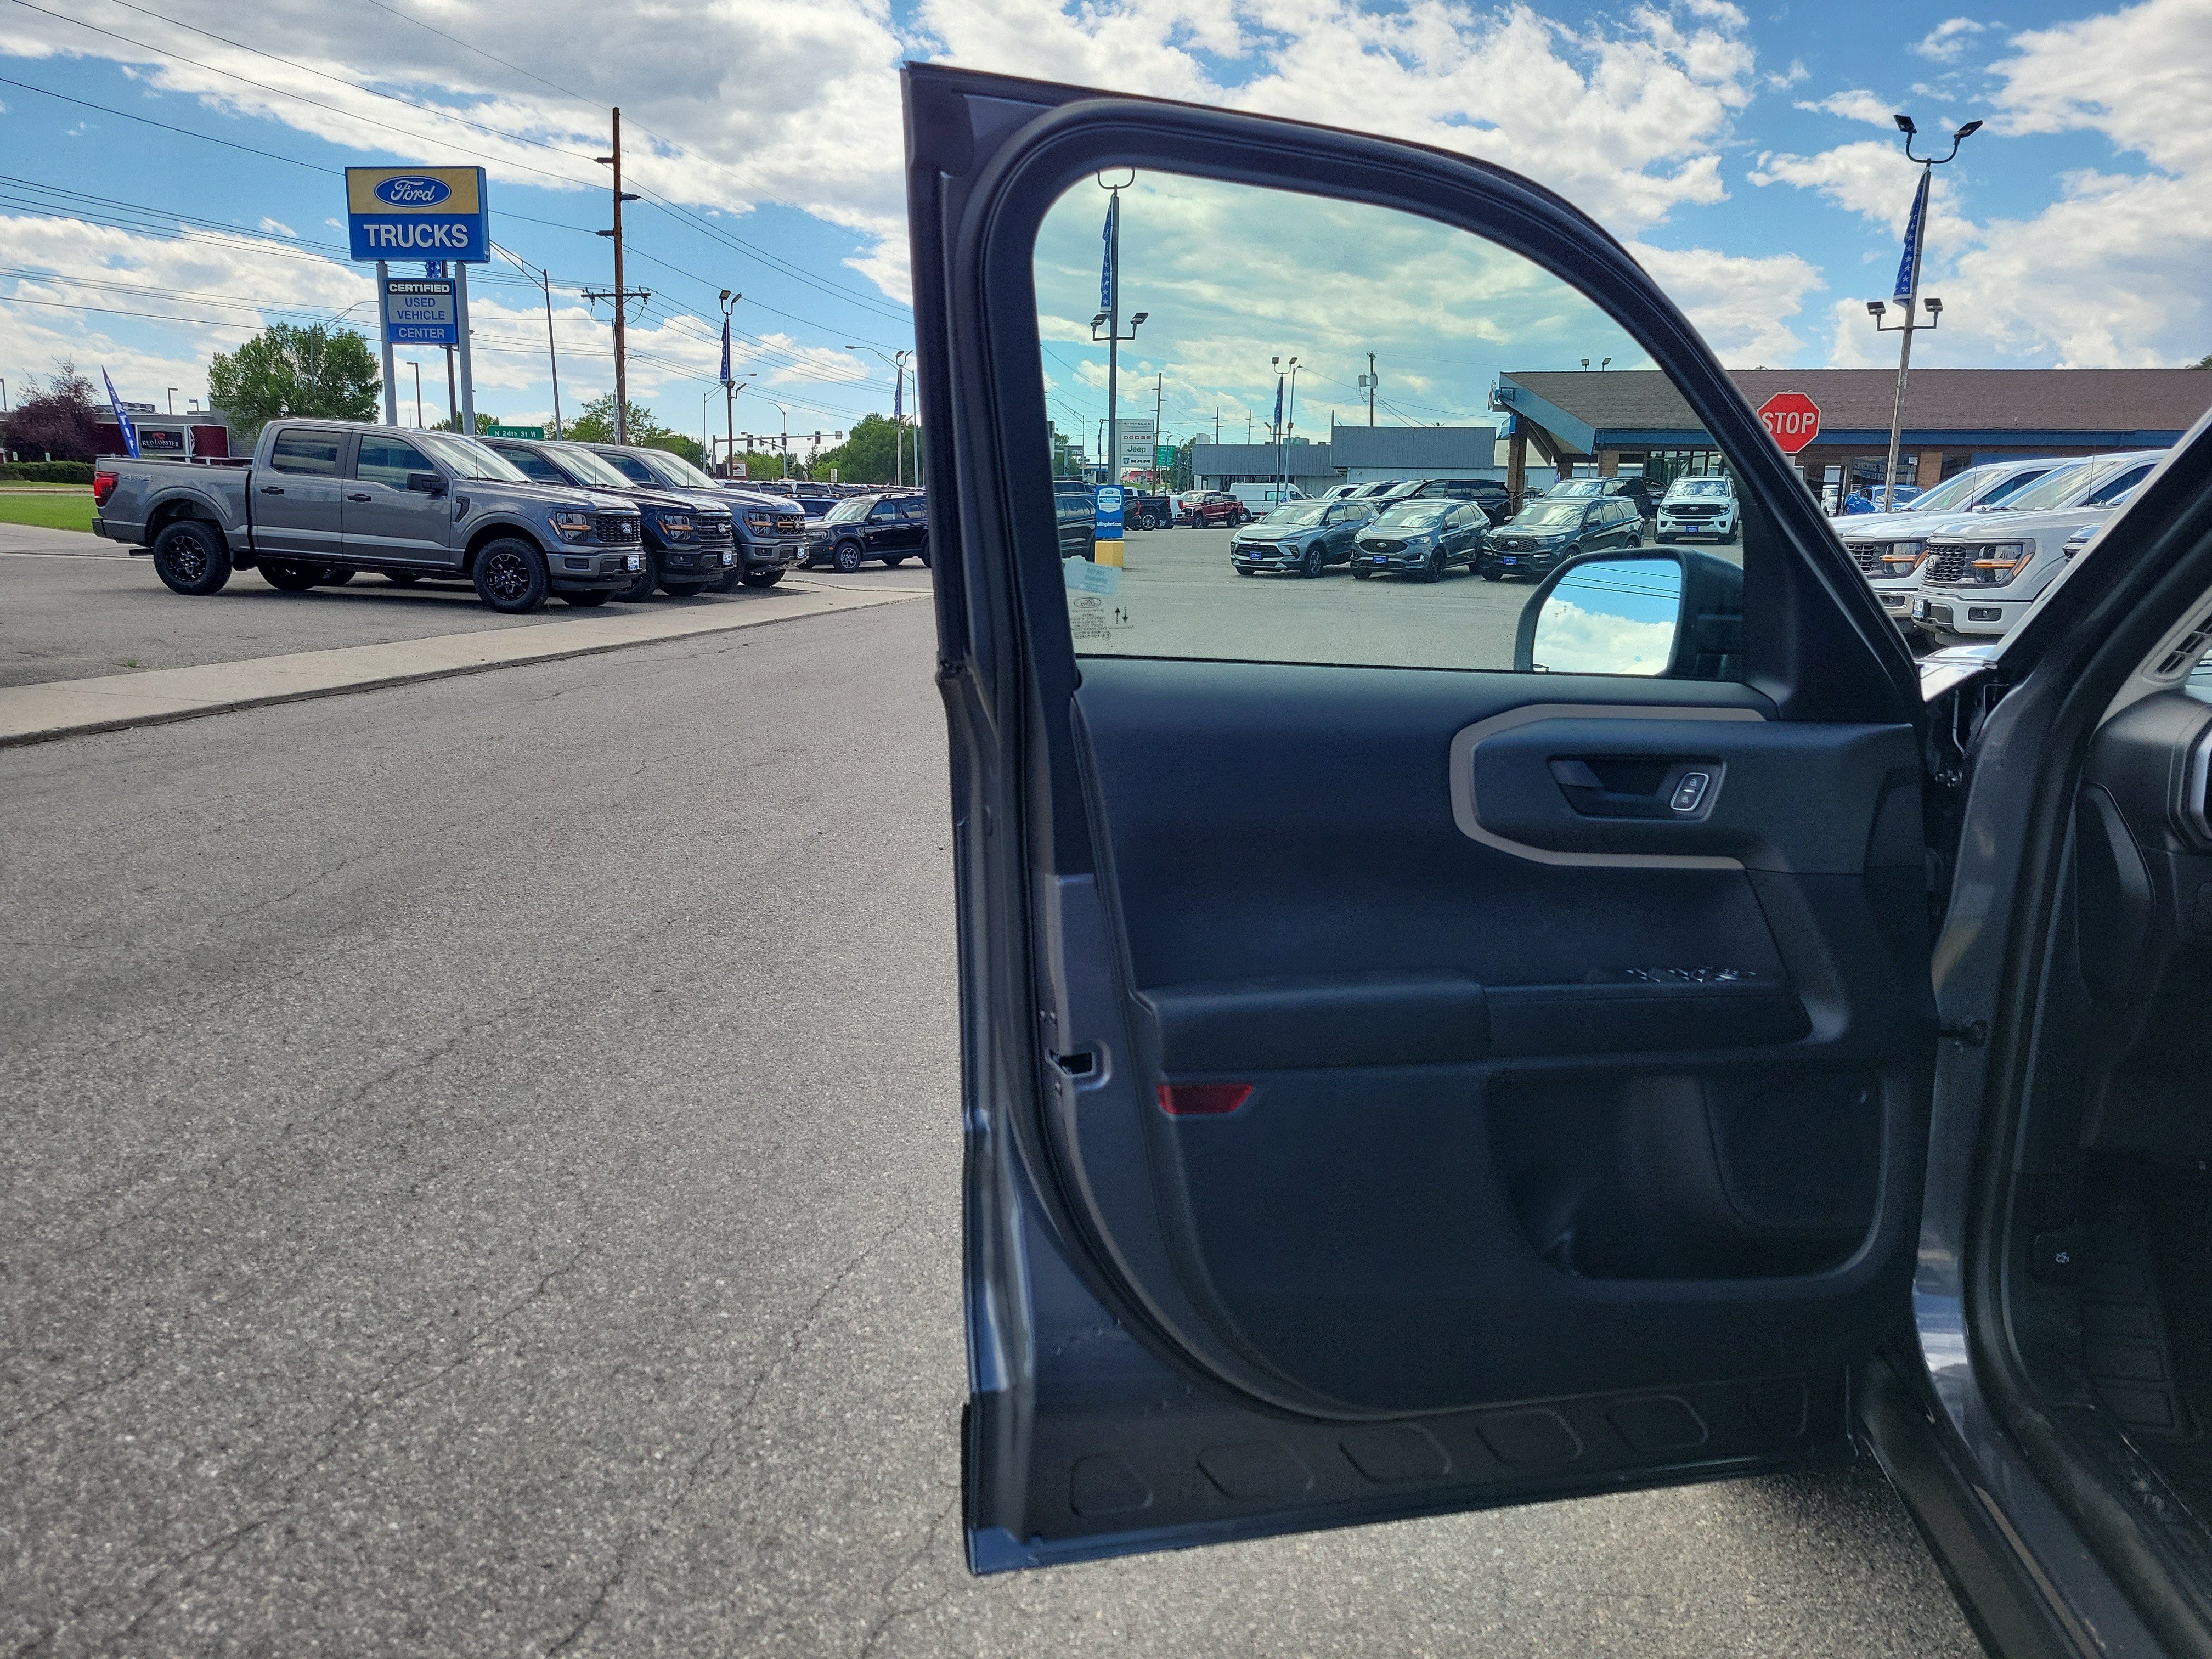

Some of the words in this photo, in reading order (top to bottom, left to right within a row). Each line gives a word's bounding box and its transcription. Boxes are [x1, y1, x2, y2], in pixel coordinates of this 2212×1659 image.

[390, 180, 436, 201] Ford
[363, 224, 469, 247] TRUCKS
[388, 284, 450, 292] CERTIFIED
[405, 297, 436, 307] USED
[397, 310, 445, 320] VEHICLE
[398, 328, 445, 338] CENTER
[1762, 411, 1815, 434] STOP
[154, 438, 179, 447] LOBSTER
[1127, 445, 1146, 454] Jeep
[122, 474, 154, 482] 44
